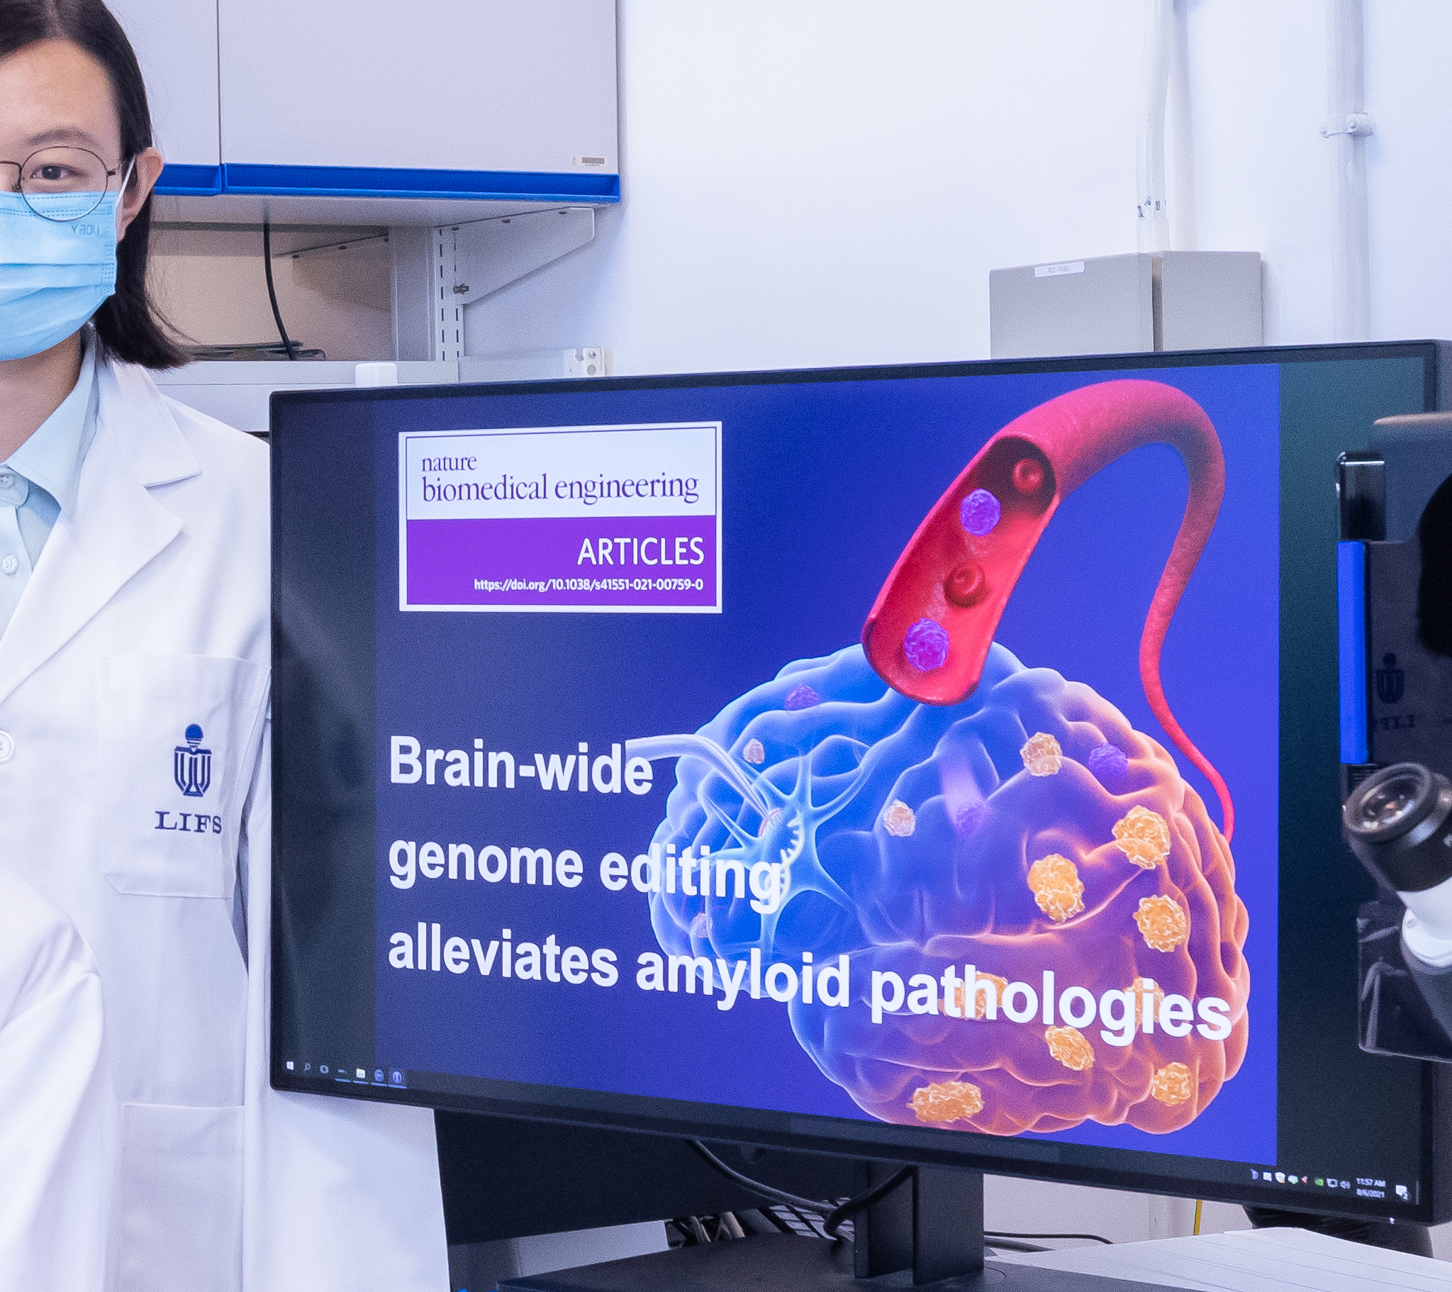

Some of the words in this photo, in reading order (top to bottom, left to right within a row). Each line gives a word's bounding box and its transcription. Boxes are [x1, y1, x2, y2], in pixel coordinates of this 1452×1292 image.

[421, 454, 478, 473] nature
[422, 473, 548, 503] biomedical
[554, 472, 700, 506] engineering
[577, 536, 706, 566] ARTICLES
[474, 577, 704, 593] https://doi.org/10.1038/s41551-021-00759-0
[389, 735, 654, 795] Brain-wide
[154, 810, 223, 835] LIFS
[389, 837, 584, 890] genome
[600, 842, 782, 914] editing
[388, 921, 619, 987] alleviates
[635, 948, 850, 1011] amyloid
[871, 963, 1233, 1047] pathologies
